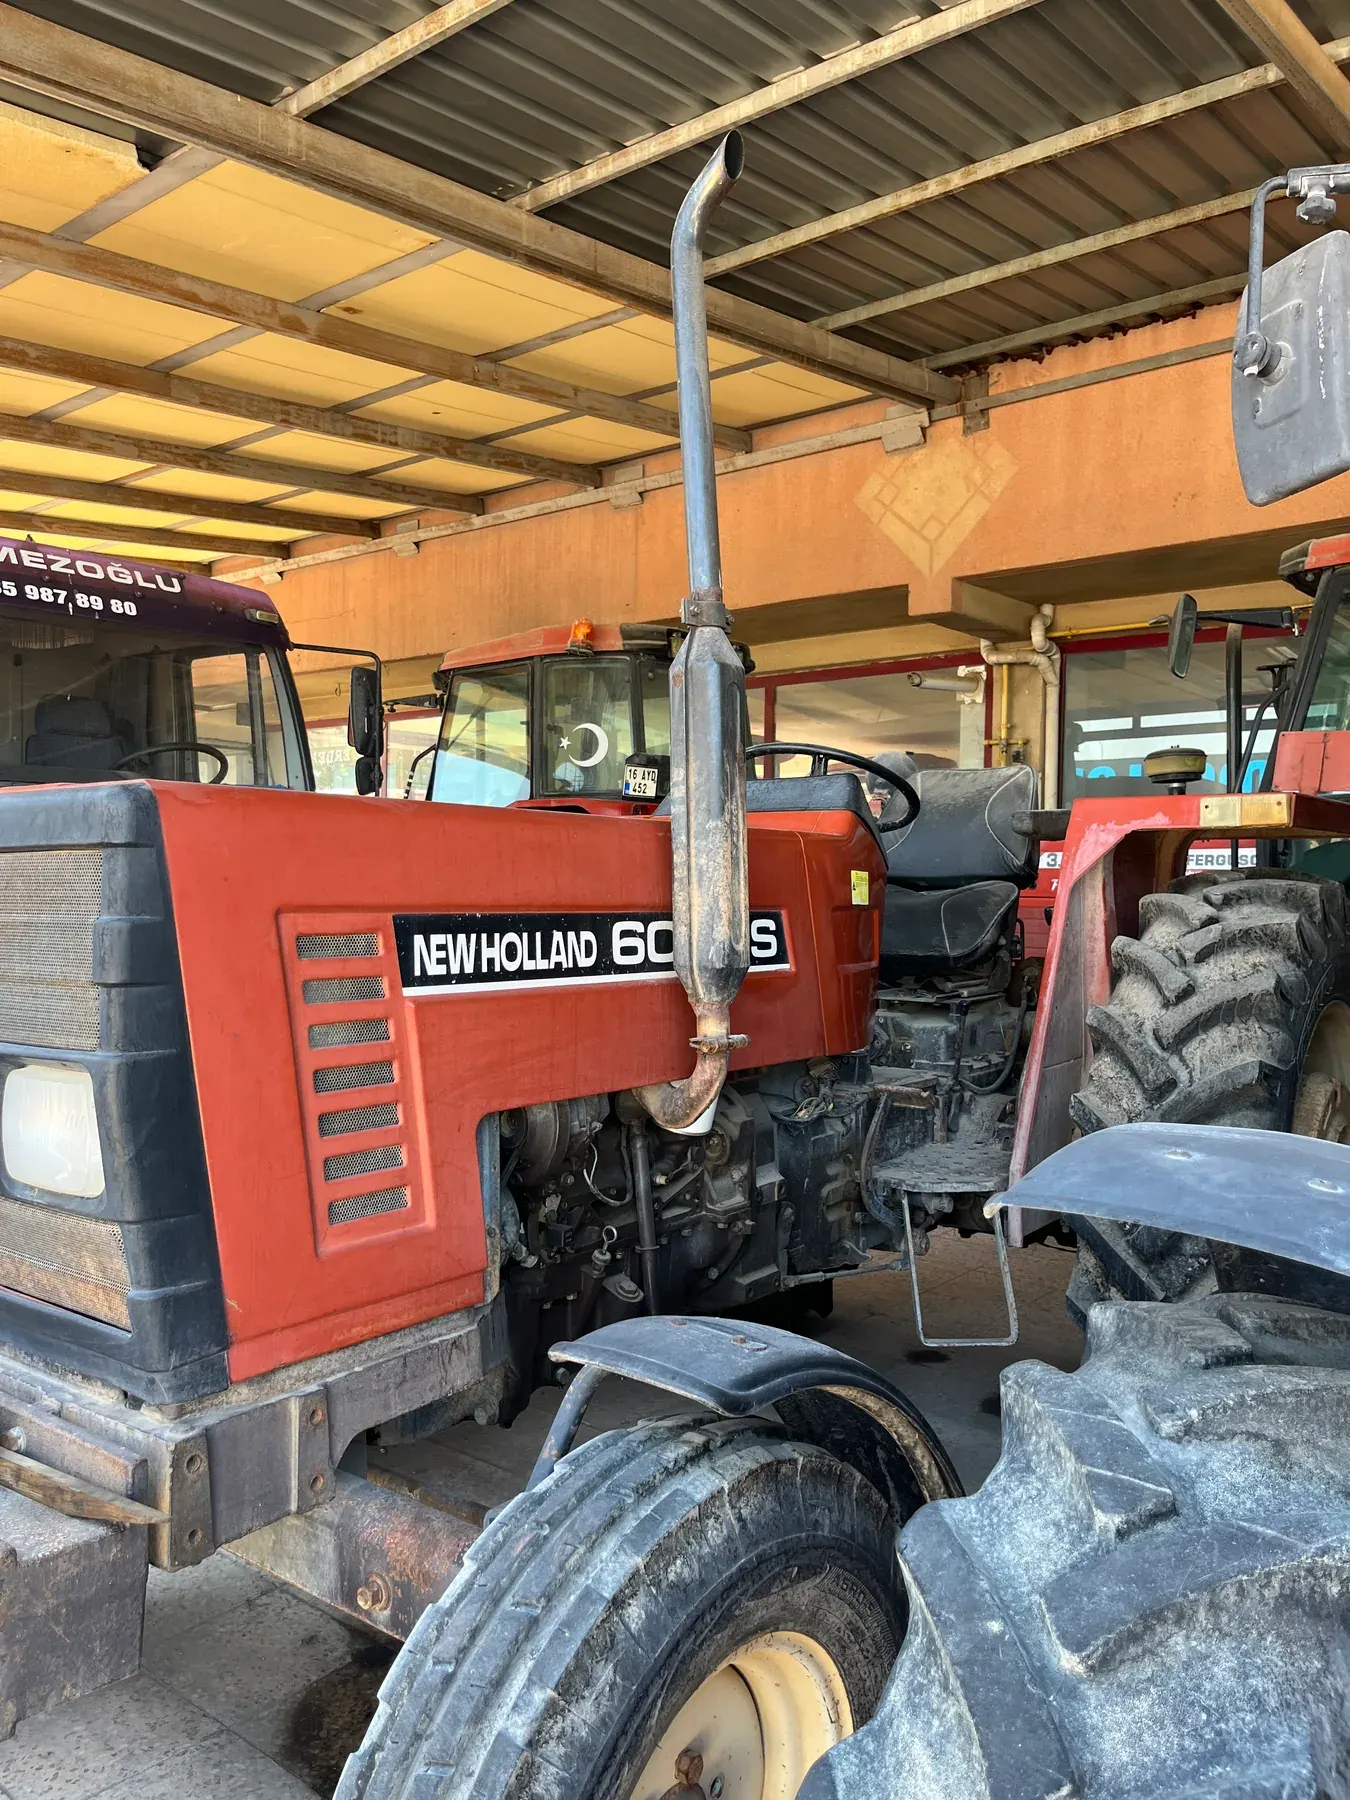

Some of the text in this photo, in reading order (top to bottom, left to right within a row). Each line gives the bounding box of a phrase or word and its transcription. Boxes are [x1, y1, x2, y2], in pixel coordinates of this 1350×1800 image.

[0, 580, 138, 616] 5 987 89 80
[628, 768, 656, 782] 16 AYD
[632, 782, 648, 794] 452
[413, 933, 477, 977] NEW
[481, 930, 598, 973] HOLLAND
